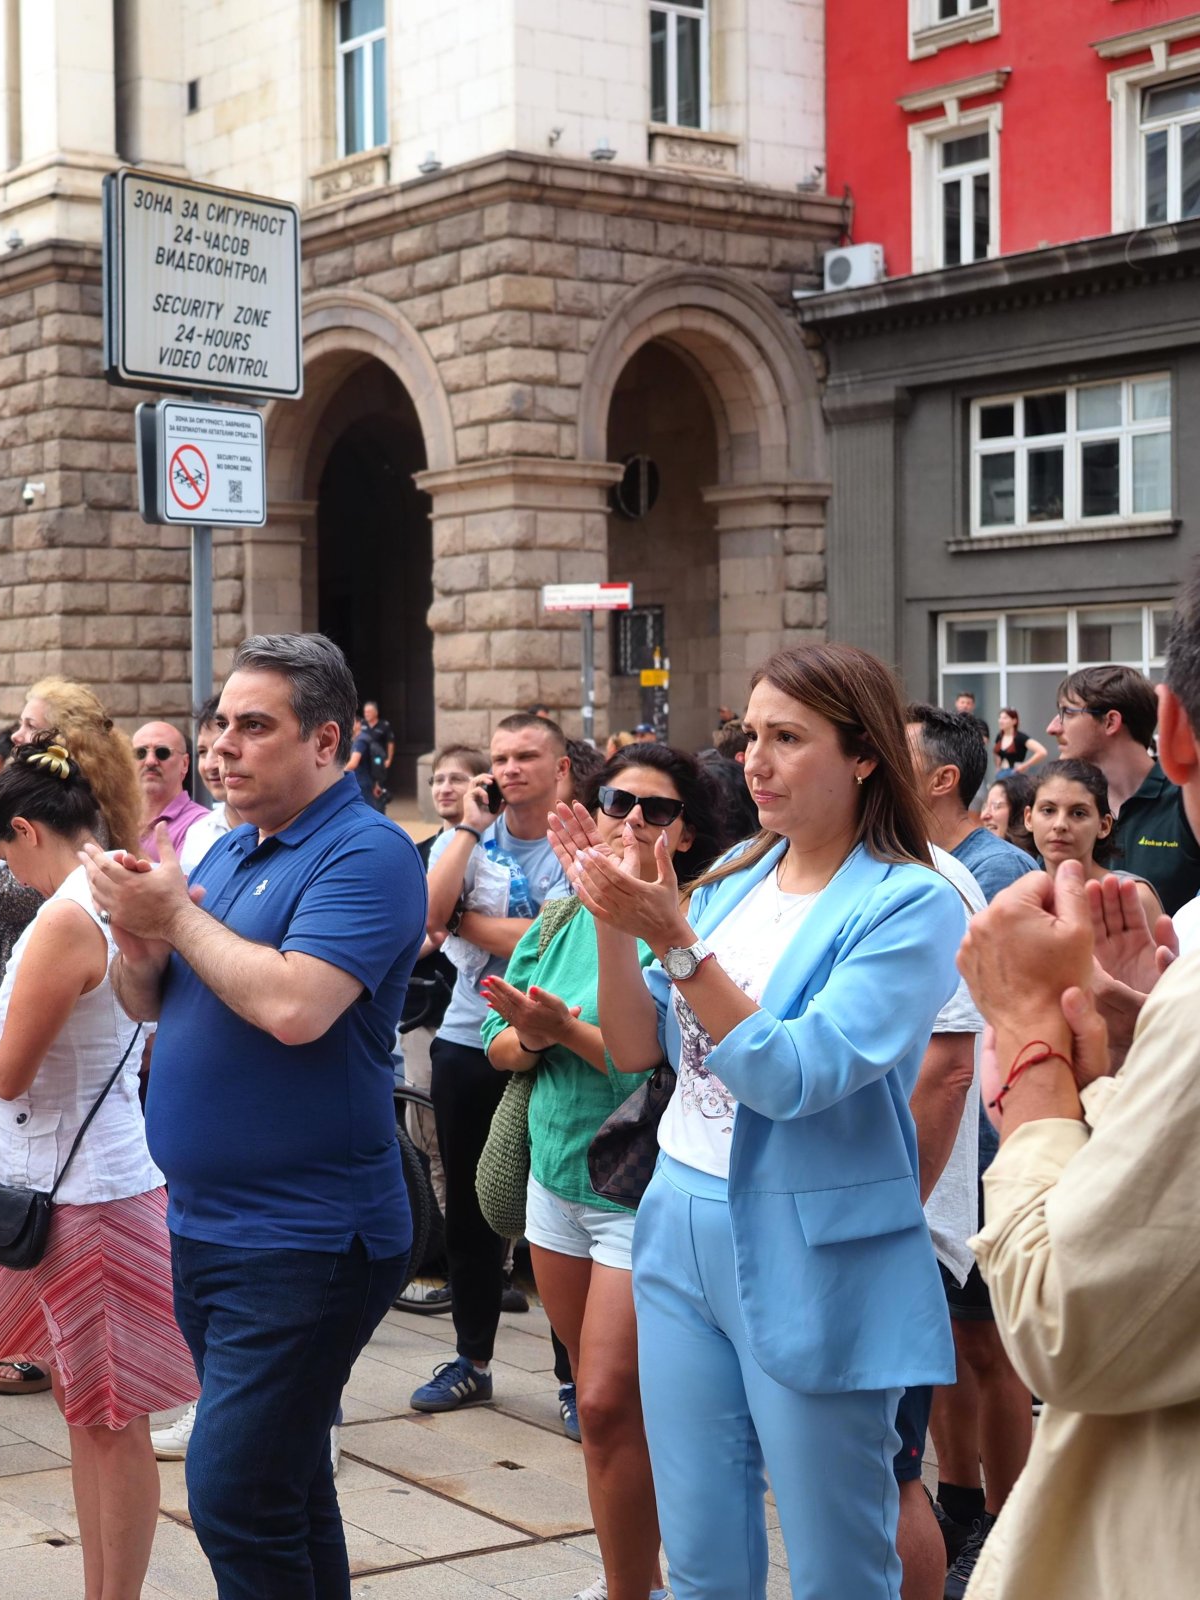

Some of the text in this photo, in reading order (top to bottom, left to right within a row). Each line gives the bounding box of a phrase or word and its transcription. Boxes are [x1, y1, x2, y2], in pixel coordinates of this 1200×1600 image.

[133, 189, 287, 236] ЗОНА ЗА СИГУРНОСТ
[174, 225, 250, 256] 24-ЧАСОВ
[155, 247, 268, 285] ВИДЕОКОНТРОЛ
[153, 293, 271, 328] SECURITY ZONE
[174, 324, 252, 351] 24-HOURS
[158, 347, 269, 378] VIDEO CONTROL
